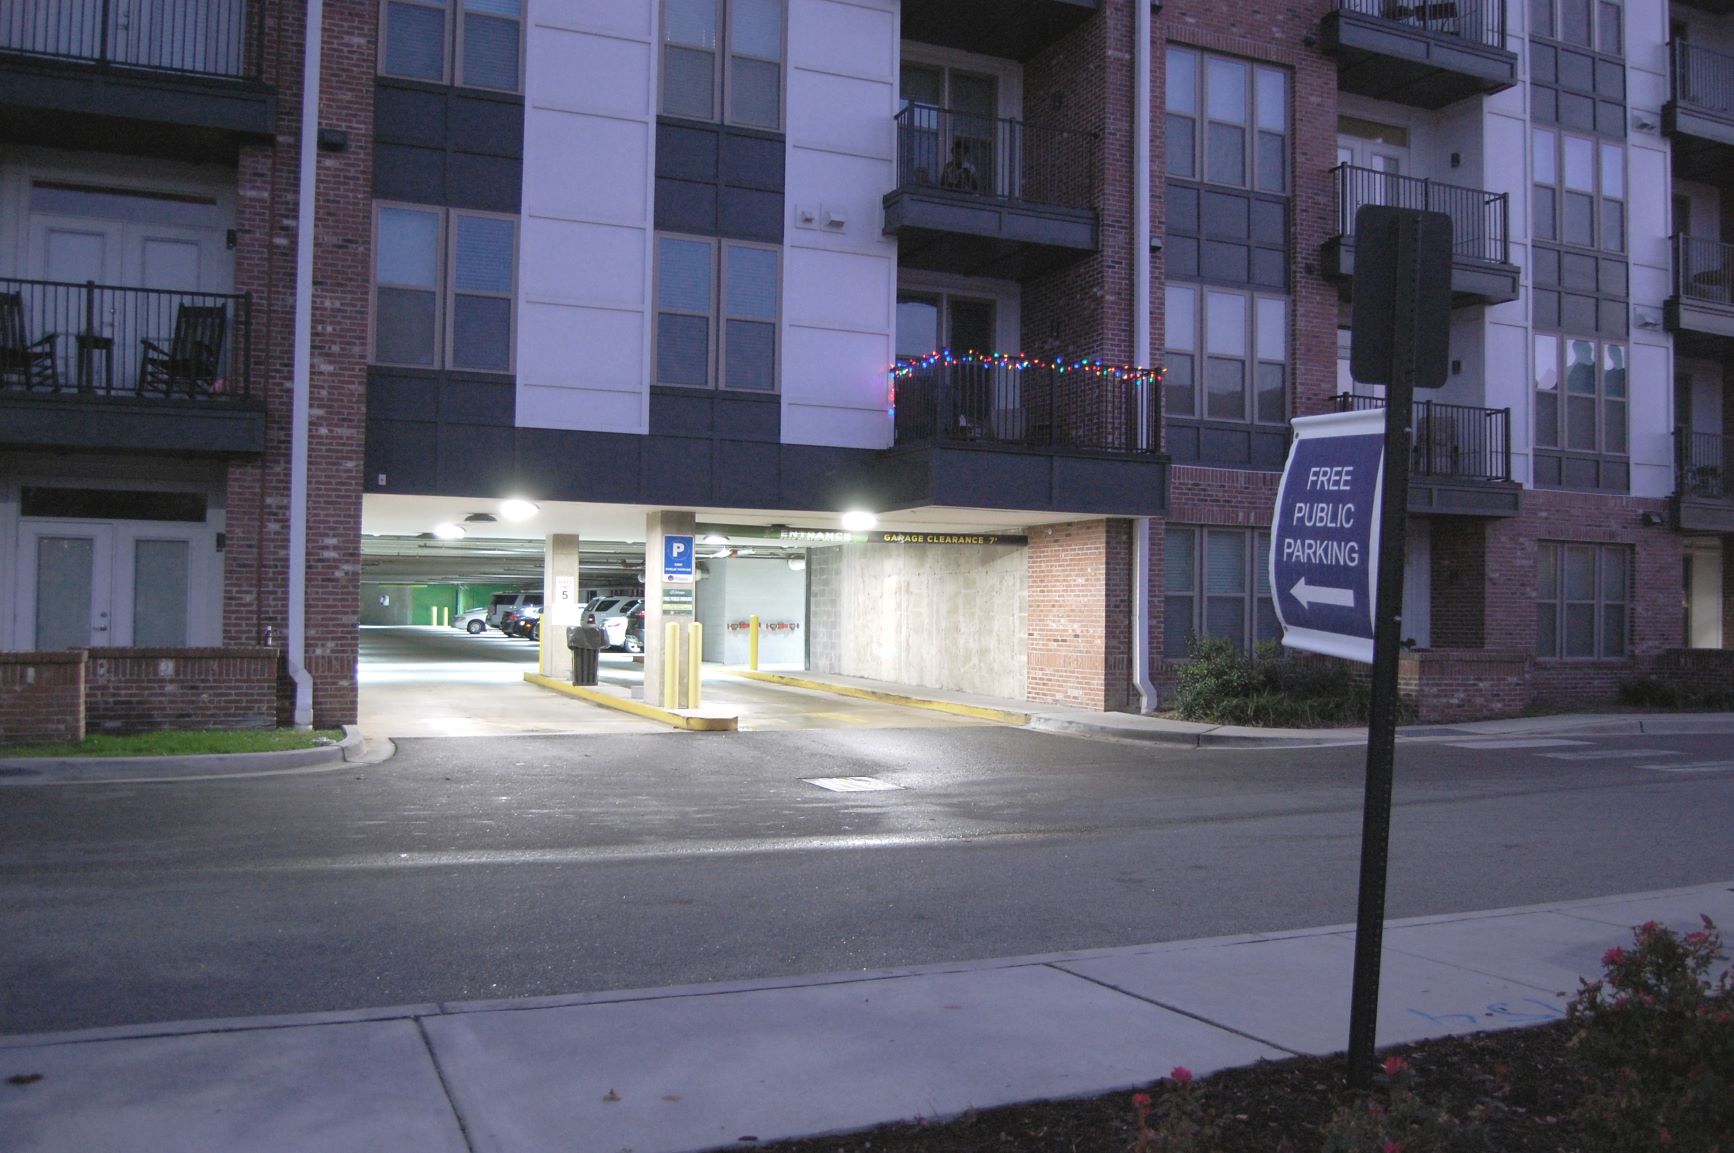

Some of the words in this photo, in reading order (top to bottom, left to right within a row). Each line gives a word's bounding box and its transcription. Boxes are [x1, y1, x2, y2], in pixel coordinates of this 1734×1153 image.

[1306, 466, 1354, 490] FREE
[1293, 503, 1355, 528] PUBLIC
[884, 534, 924, 543] GARAGE
[927, 535, 984, 544] CLEARANCE
[673, 543, 685, 557] P
[1283, 539, 1359, 566] PARKING
[562, 590, 569, 600] 5
